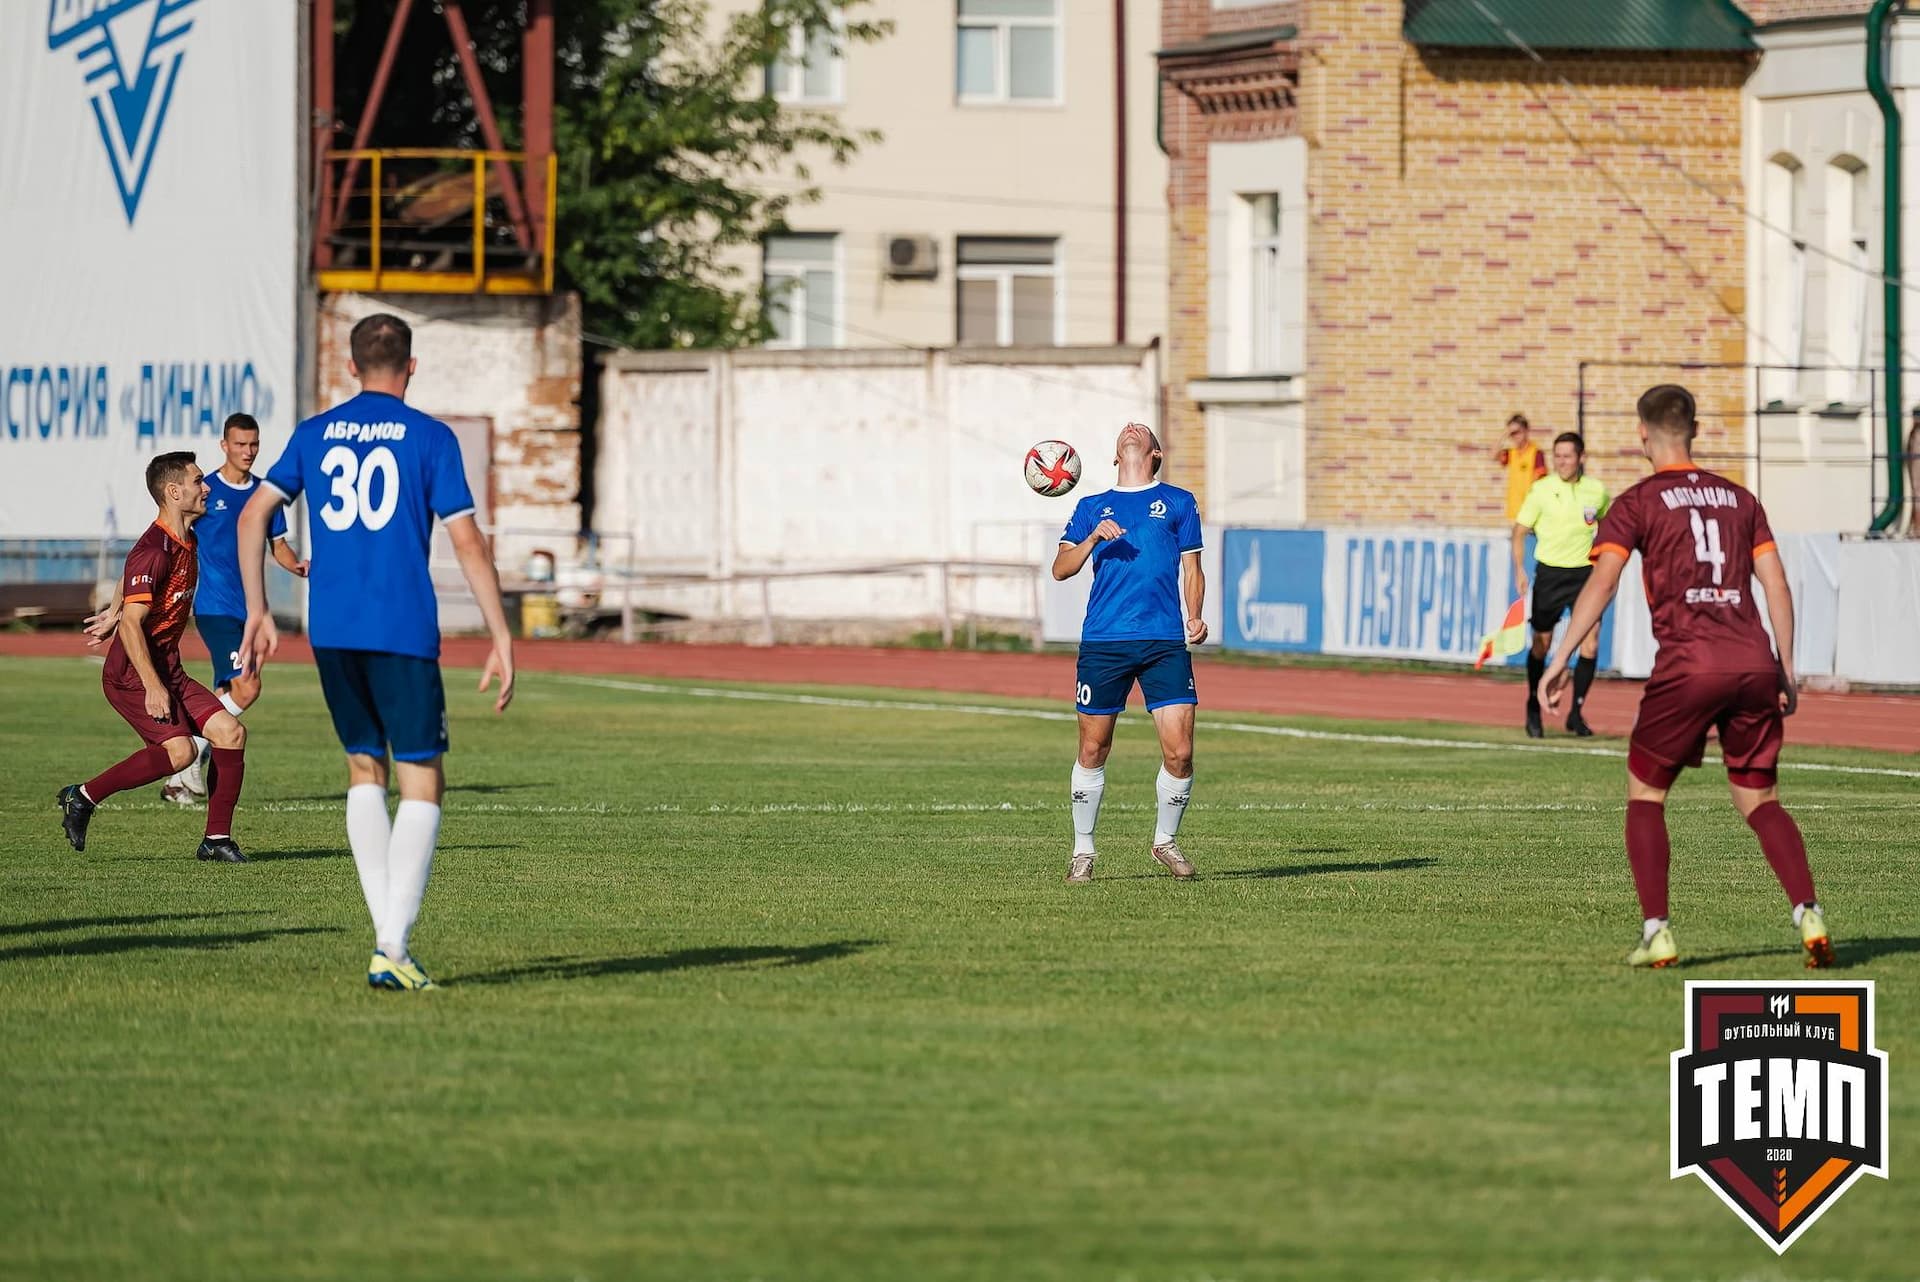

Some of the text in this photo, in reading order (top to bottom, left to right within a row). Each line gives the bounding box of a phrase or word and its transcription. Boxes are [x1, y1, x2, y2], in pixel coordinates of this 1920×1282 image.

[0, 364, 108, 441] СТОРИЯ
[323, 420, 407, 442] АБРАМОВ
[320, 445, 400, 531] 30
[1690, 508, 1726, 585] 4
[1344, 538, 1489, 654] ГАЗПРОМ
